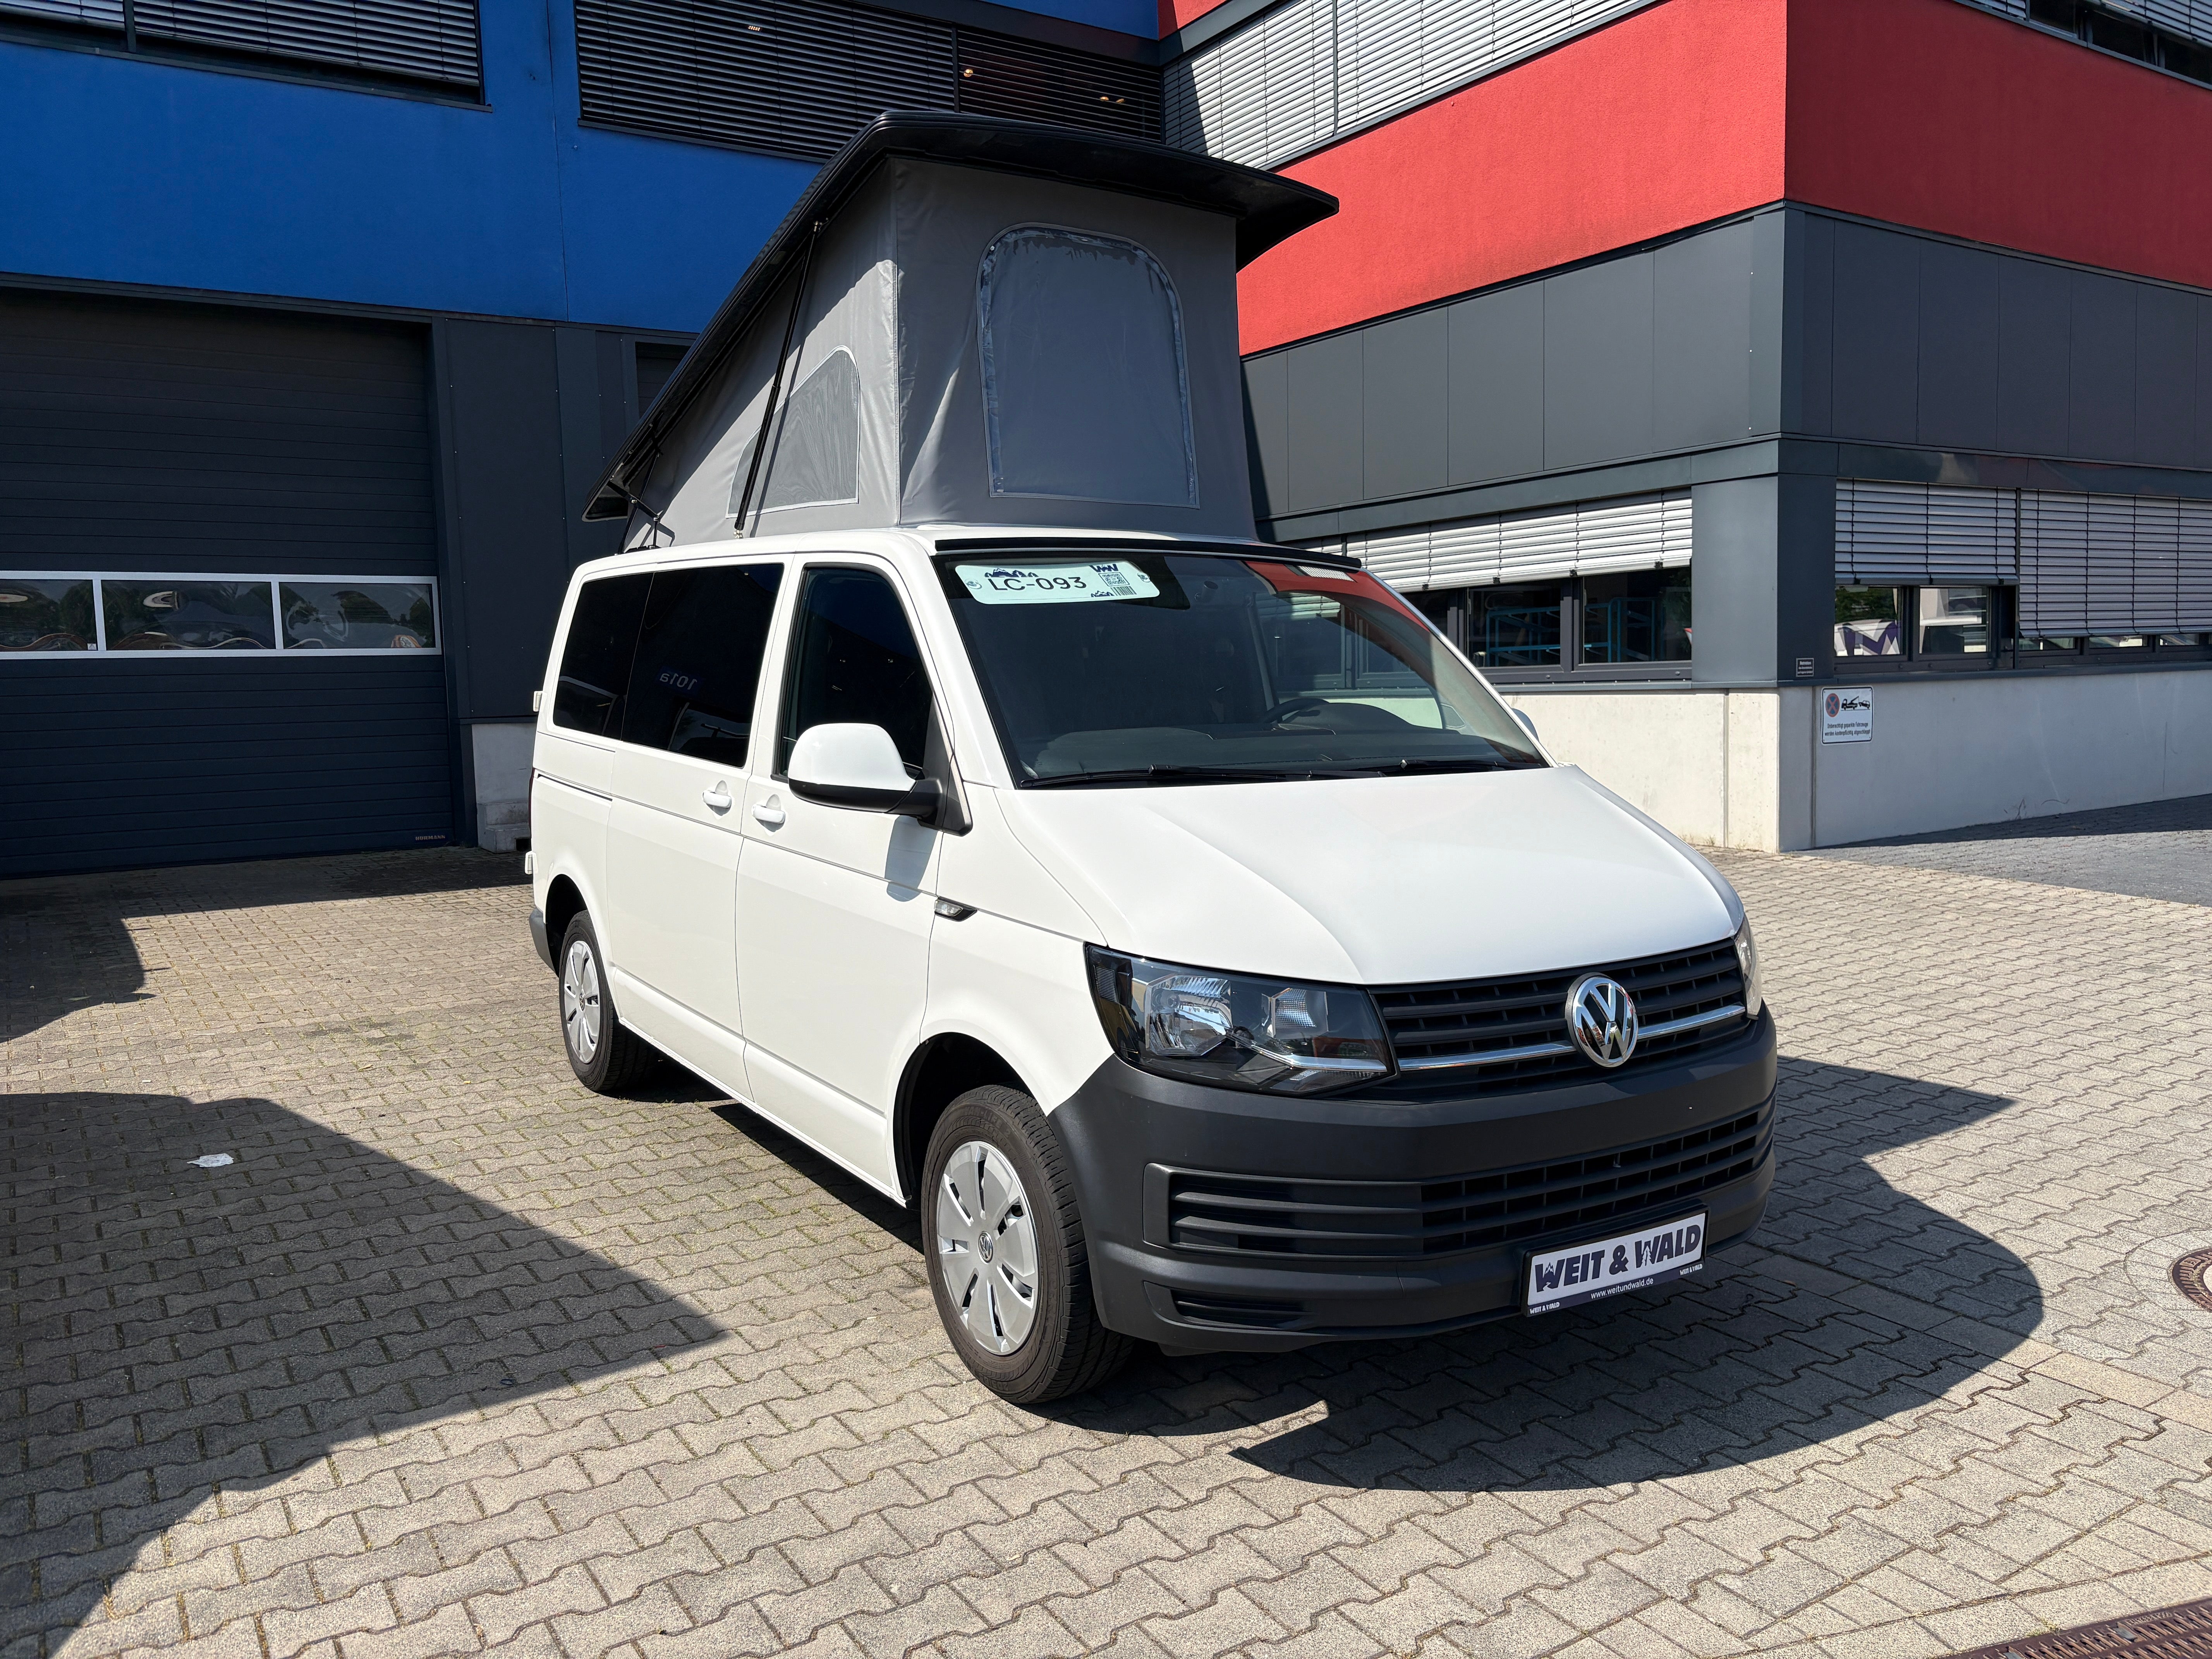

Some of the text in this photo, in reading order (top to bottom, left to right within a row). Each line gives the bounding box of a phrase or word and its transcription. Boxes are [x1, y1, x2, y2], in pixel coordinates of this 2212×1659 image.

[987, 576, 1087, 591] LC-093
[1535, 1224, 1701, 1293] WEIT & WALD
[1590, 1278, 1654, 1299] www.weitundwald.de
[1530, 1306, 1542, 1314] WEIT
[1546, 1302, 1560, 1310] WALD
